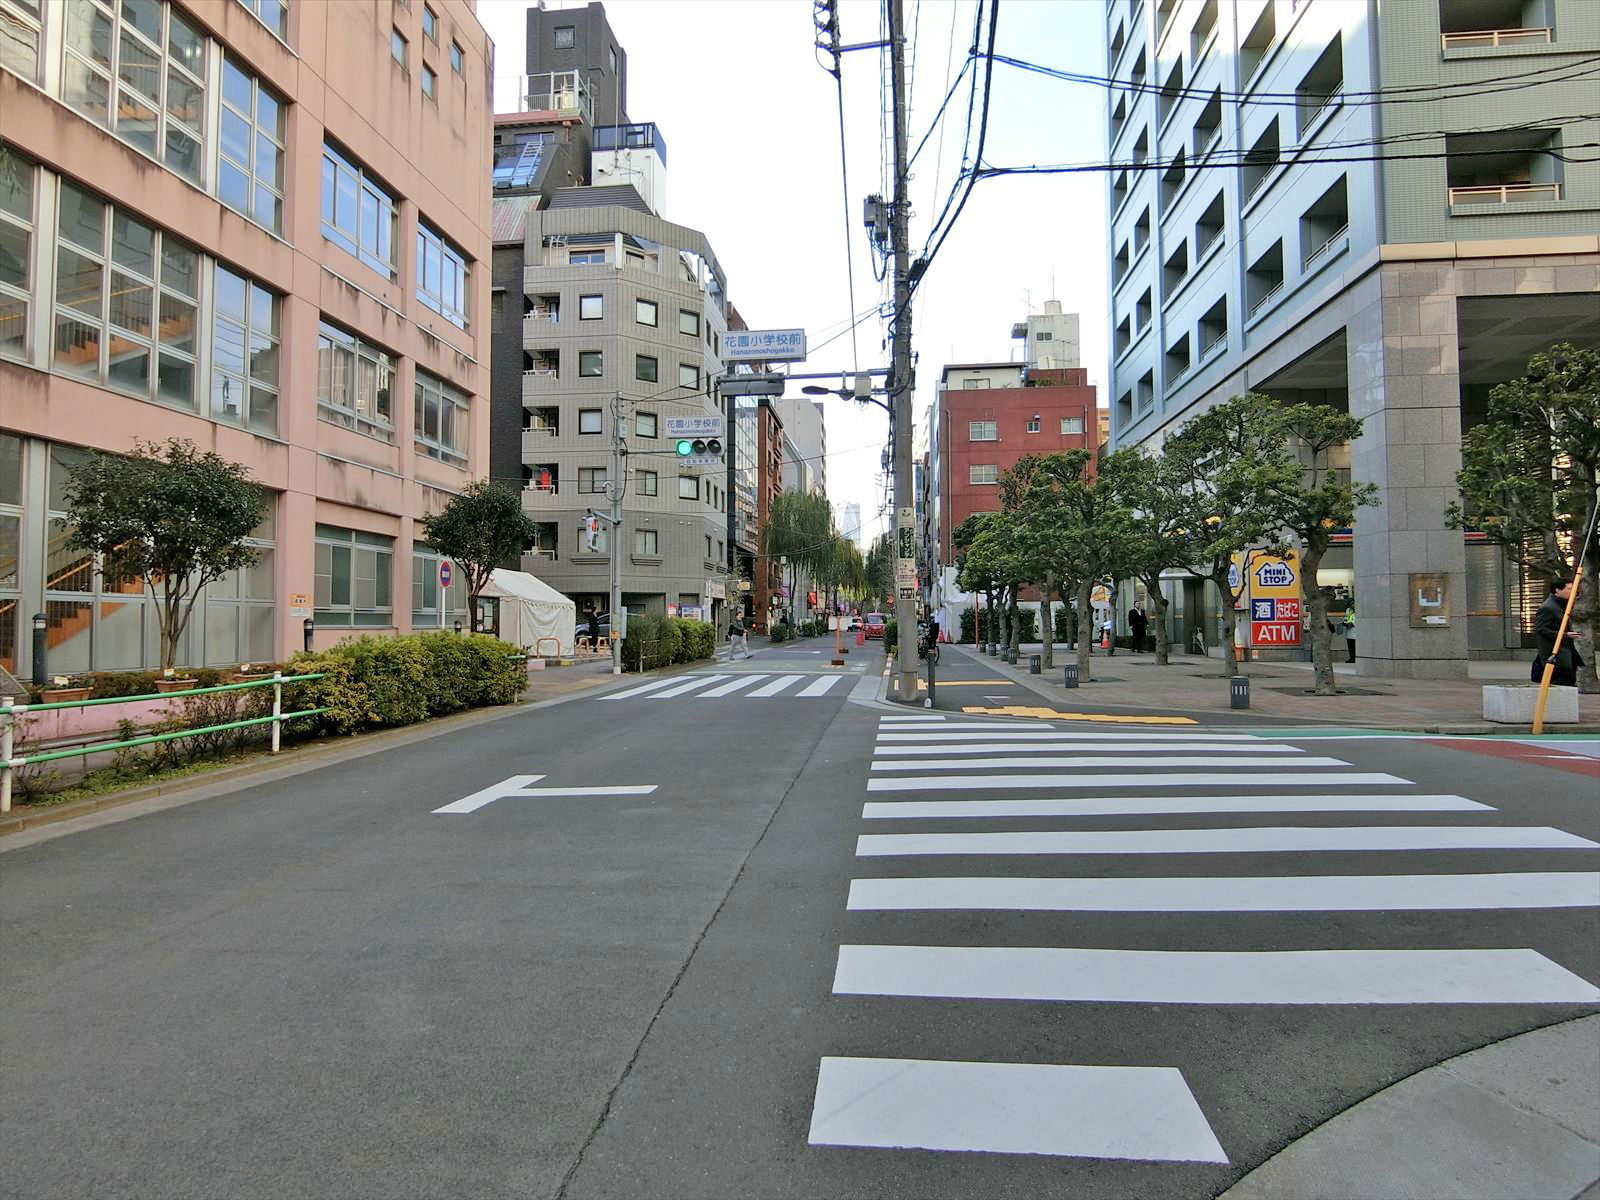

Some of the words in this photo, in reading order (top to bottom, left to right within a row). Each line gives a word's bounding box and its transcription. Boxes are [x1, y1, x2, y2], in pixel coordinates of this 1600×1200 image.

[725, 333, 801, 348] 花園小学校前
[731, 347, 795, 356] Hanazonoshogakko
[667, 418, 720, 428] 花園小学校前
[1264, 568, 1286, 576] MINI
[1263, 576, 1287, 584] STOP
[1255, 602, 1272, 619] 酒
[1276, 602, 1299, 618] たばこ
[1258, 625, 1295, 641] ATM
